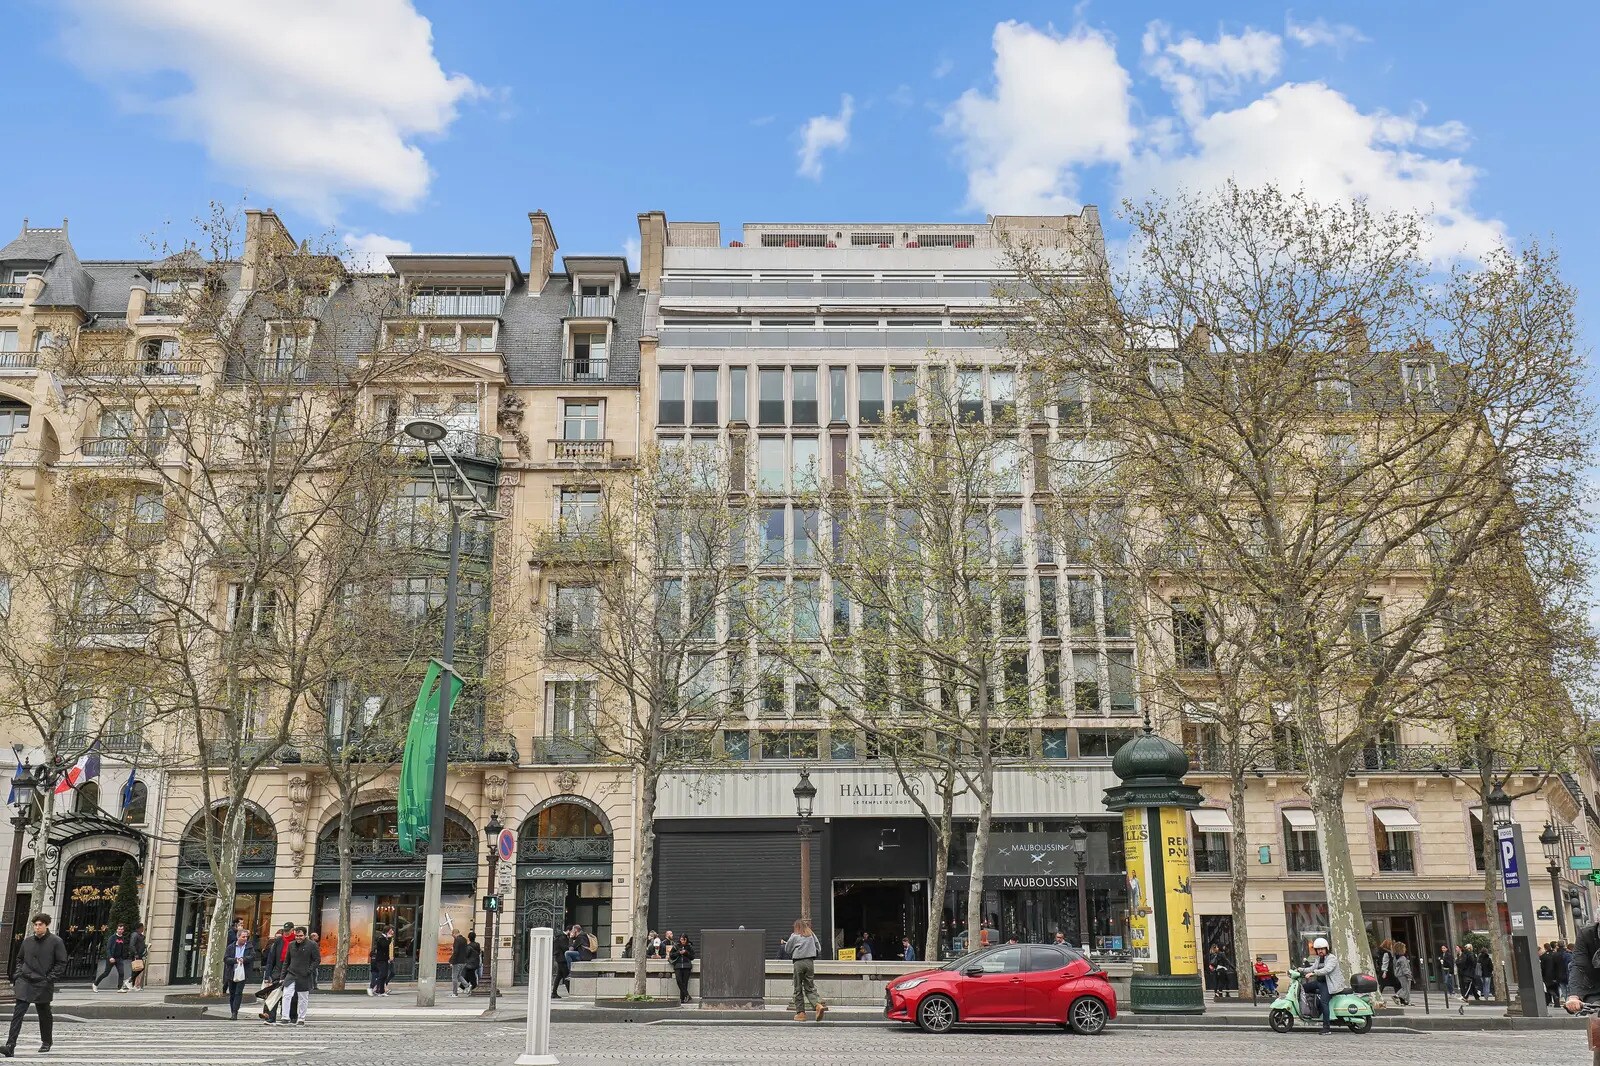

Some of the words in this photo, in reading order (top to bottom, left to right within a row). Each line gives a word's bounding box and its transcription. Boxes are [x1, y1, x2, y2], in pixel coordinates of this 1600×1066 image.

[840, 783, 893, 797] HALLE
[1011, 844, 1064, 852] MAUBOUSSIN
[1502, 841, 1514, 869] P
[526, 867, 604, 877] Guerlain
[1003, 876, 1078, 887] MAUBOUSSIN
